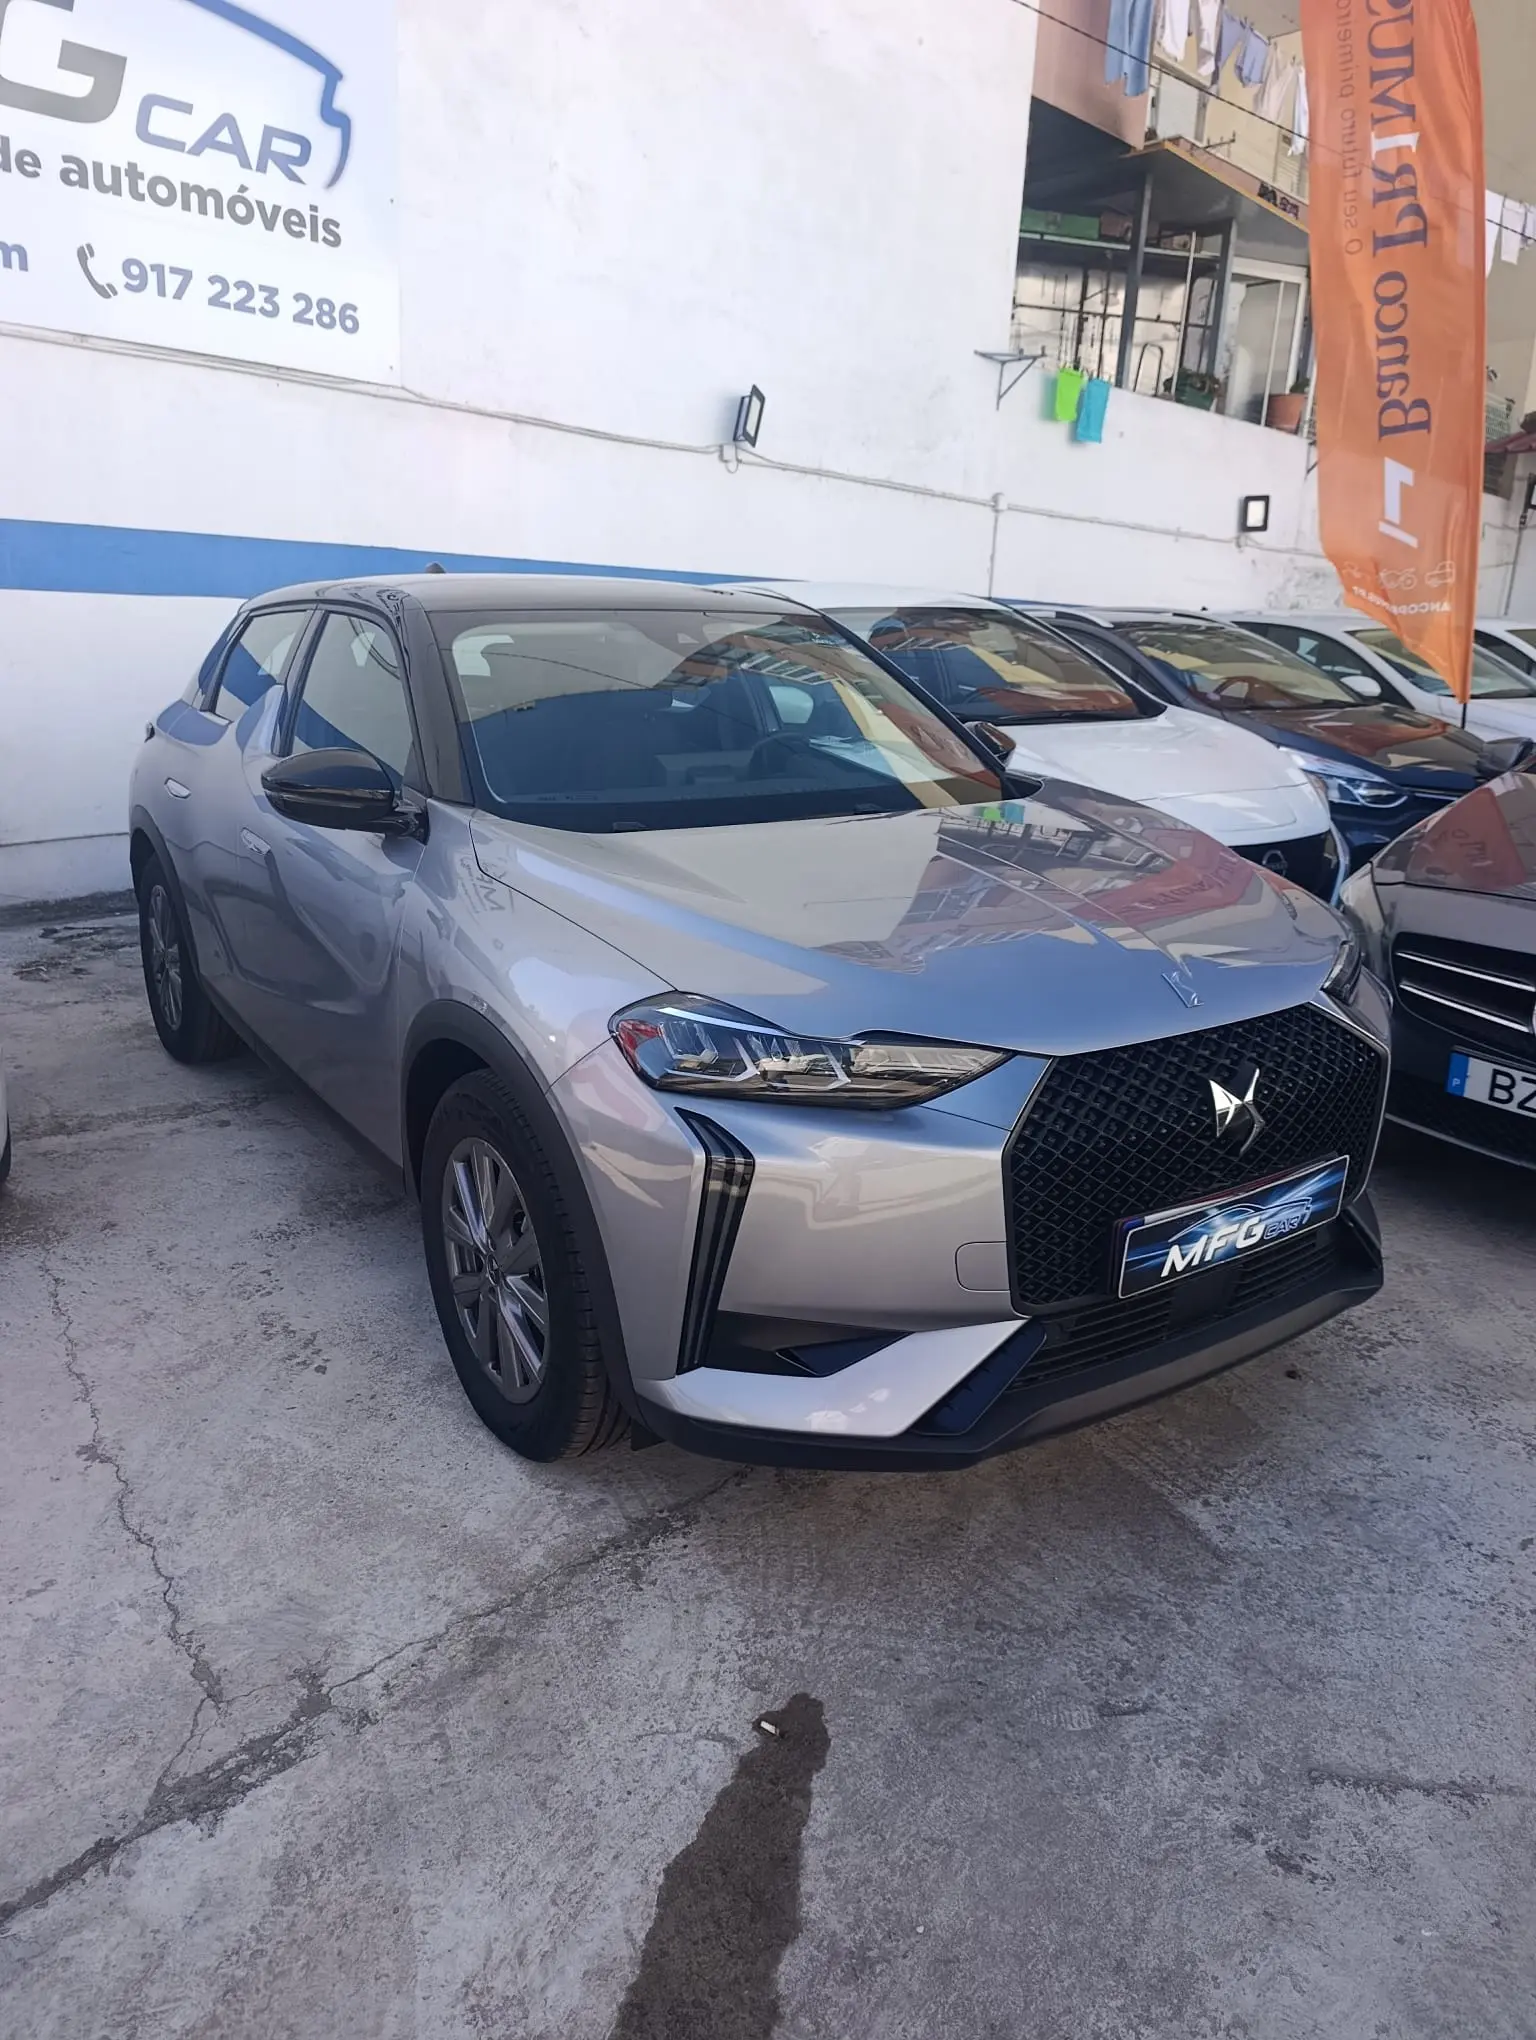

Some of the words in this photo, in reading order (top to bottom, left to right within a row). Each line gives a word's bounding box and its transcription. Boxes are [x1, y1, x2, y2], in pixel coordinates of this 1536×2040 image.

[136, 93, 312, 185] CAR
[59, 154, 342, 248] automóveis
[121, 257, 193, 301] 917
[207, 275, 280, 319] 223
[292, 293, 360, 335] 286
[1488, 1068, 1536, 1114] BZ
[1160, 1216, 1266, 1278] MFG
